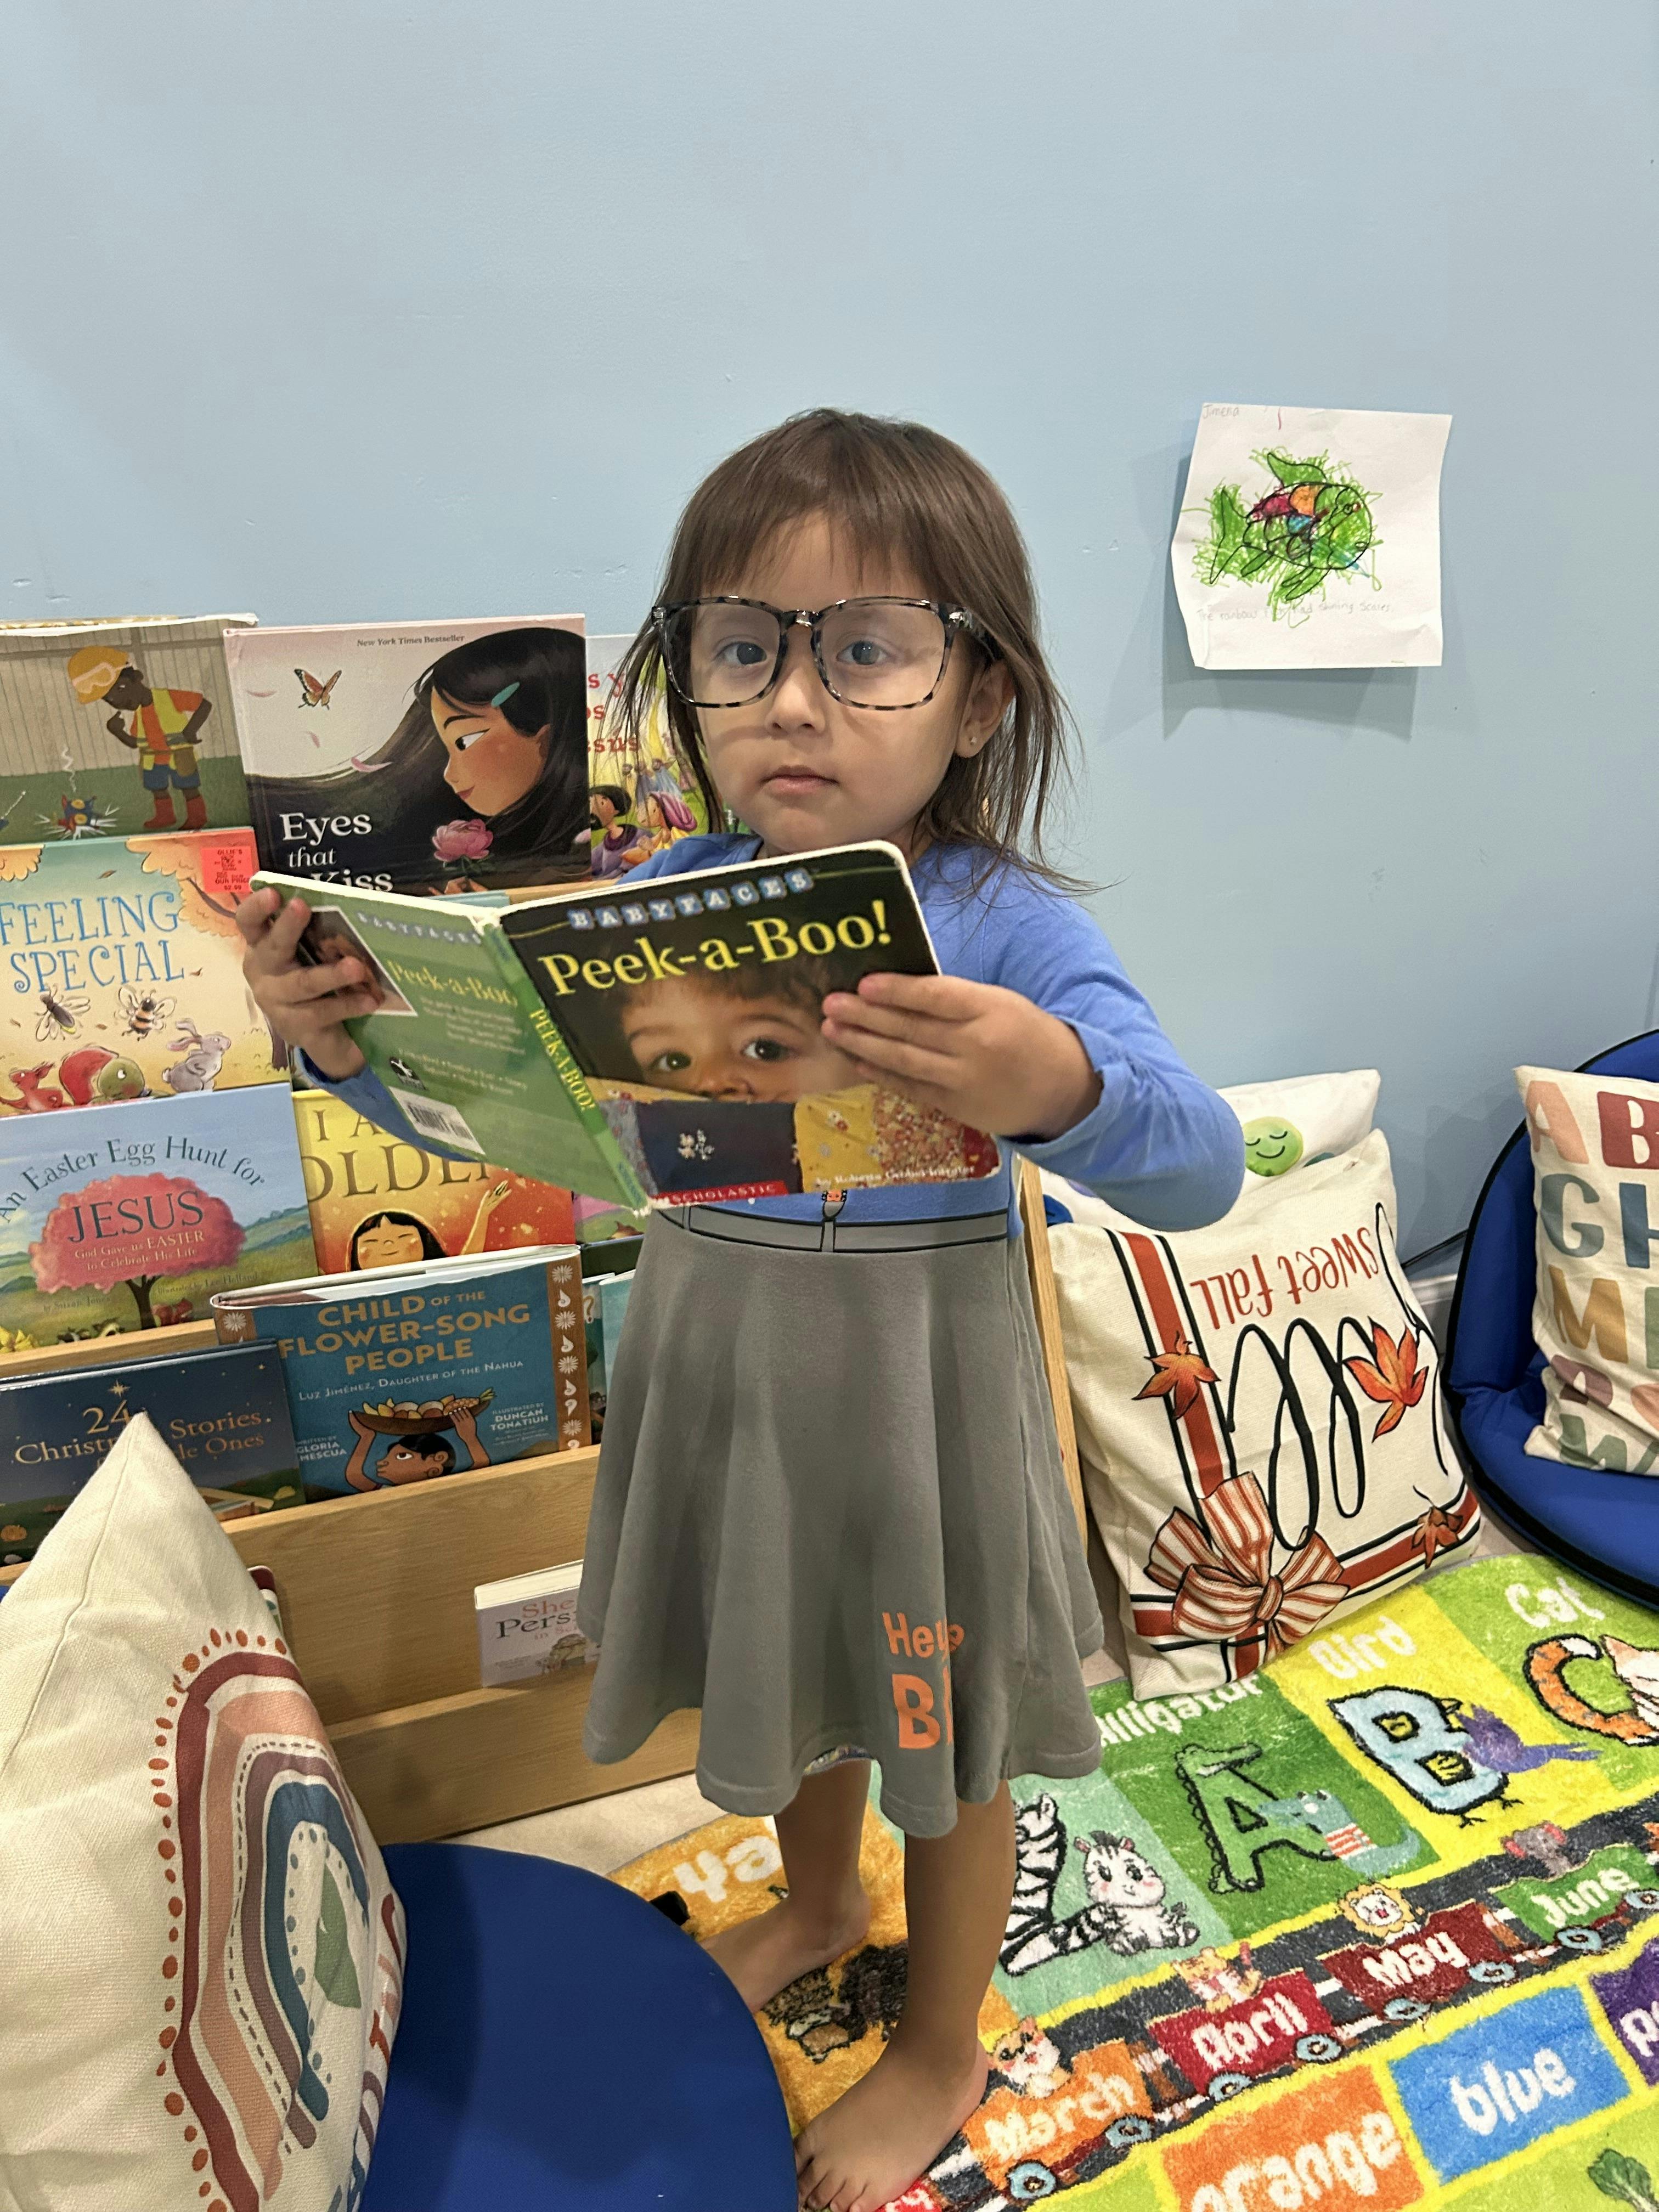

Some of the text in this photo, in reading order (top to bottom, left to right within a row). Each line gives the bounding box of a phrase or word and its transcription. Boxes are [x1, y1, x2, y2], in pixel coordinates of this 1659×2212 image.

[357, 634, 466, 647] New York Times Bestseller
[279, 812, 373, 846] Eyes
[289, 847, 337, 868] that
[0, 891, 179, 946] FEELING
[568, 868, 816, 929] BABYFACES
[10, 940, 185, 994] SPECIAL
[538, 900, 892, 996] Peek-a-Boo!
[313, 1109, 330, 1142] I
[1525, 1080, 1589, 1164] A
[0, 1136, 266, 1224] An Easter Egg Hunt for
[672, 1183, 776, 1205] SCHOLASTIC
[68, 1190, 204, 1243] JESUS
[1541, 1173, 1605, 1258] G
[75, 1249, 98, 1260] God
[101, 1246, 127, 1256] Gave
[146, 1231, 205, 1250] EASTER
[100, 1254, 150, 1269] Celebrate
[177, 1246, 198, 1259] Life
[1189, 1226, 1380, 1330] sweet fall
[278, 1303, 531, 1359] FLOWER-SONG
[318, 1290, 486, 1328] CHILD OF THE
[345, 1337, 474, 1375] PEOPLE
[83, 1400, 132, 1435] 24
[170, 1412, 262, 1439] Stories
[490, 1415, 549, 1431] TONATIUH
[495, 1409, 543, 1423] DUNCAN
[205, 1435, 264, 1454] Ones
[297, 1441, 340, 1453] GLORIA
[496, 1611, 577, 1639] Pers
[1504, 1576, 1604, 1630] Cat
[1307, 1613, 1417, 1680] Bird
[1530, 1863, 1639, 1931] June
[1361, 1930, 1468, 1990] May
[1189, 1994, 1308, 2072] April
[984, 2072, 1137, 2163] March
[1449, 2046, 1577, 2138] blue
